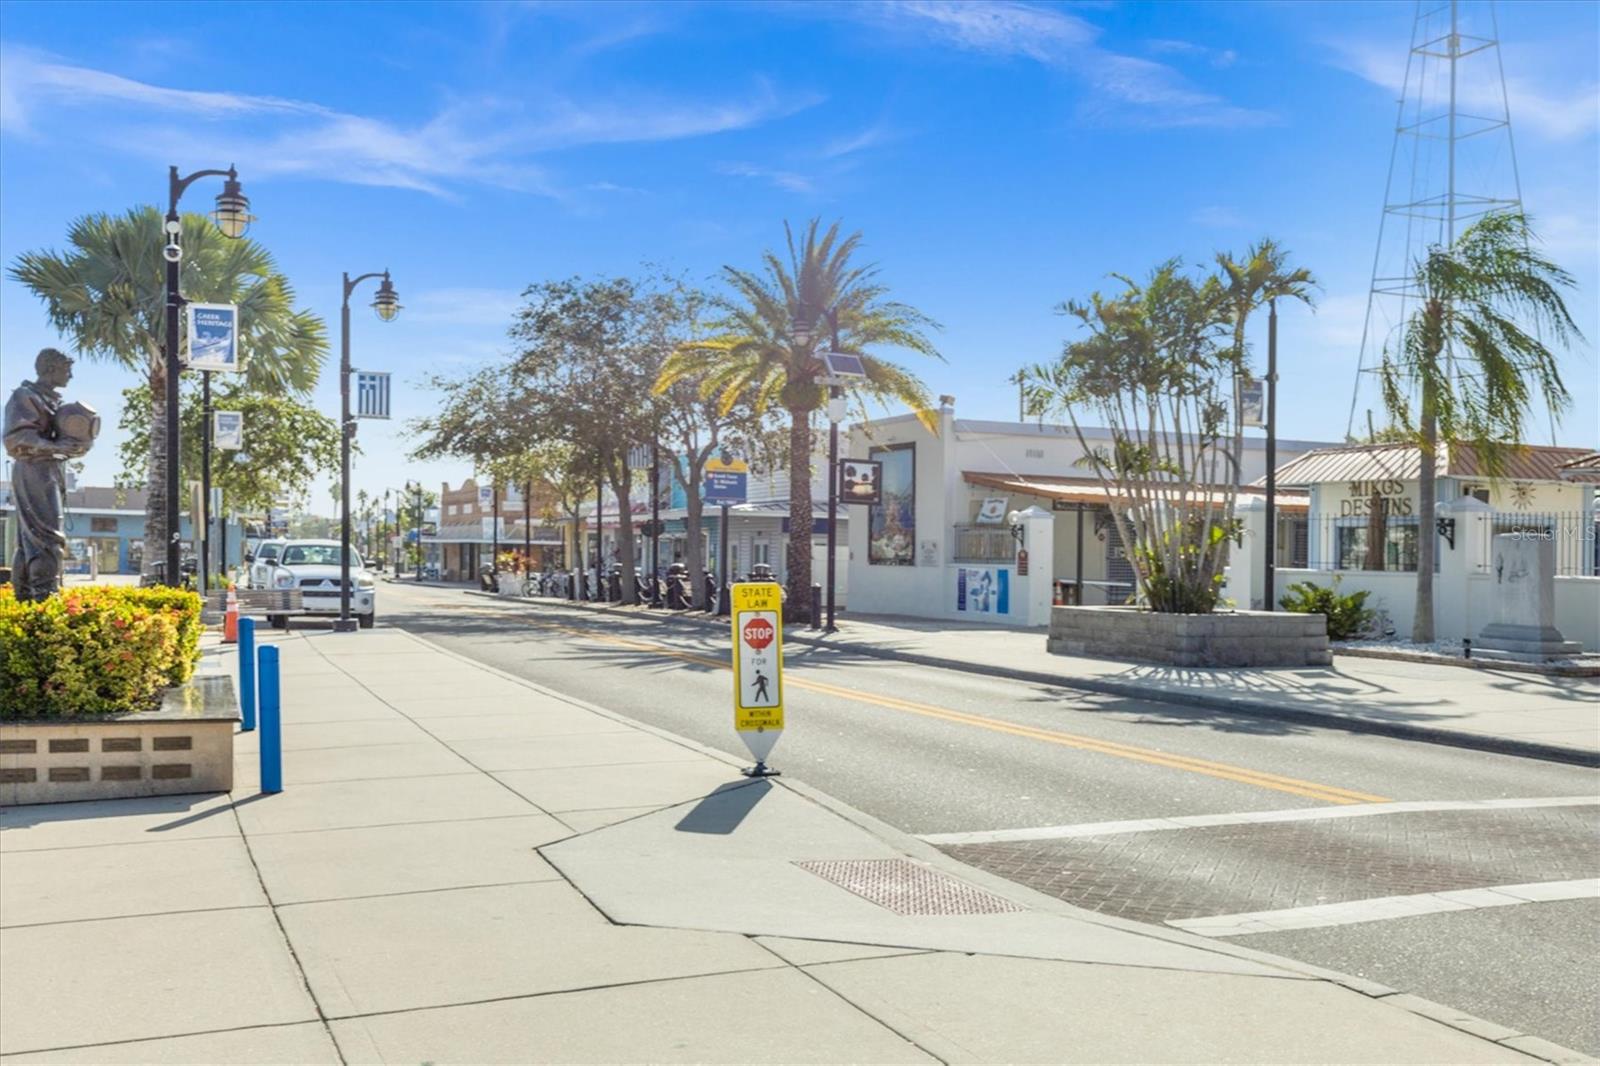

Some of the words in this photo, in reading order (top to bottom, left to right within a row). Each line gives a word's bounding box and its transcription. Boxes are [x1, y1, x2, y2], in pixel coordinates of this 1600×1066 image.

[197, 320, 233, 329] HERITAGE
[1350, 480, 1404, 497] MIKOS
[742, 587, 773, 598] STATE
[747, 600, 768, 608] LAW
[744, 627, 773, 640] STOP
[751, 657, 767, 666] FOR
